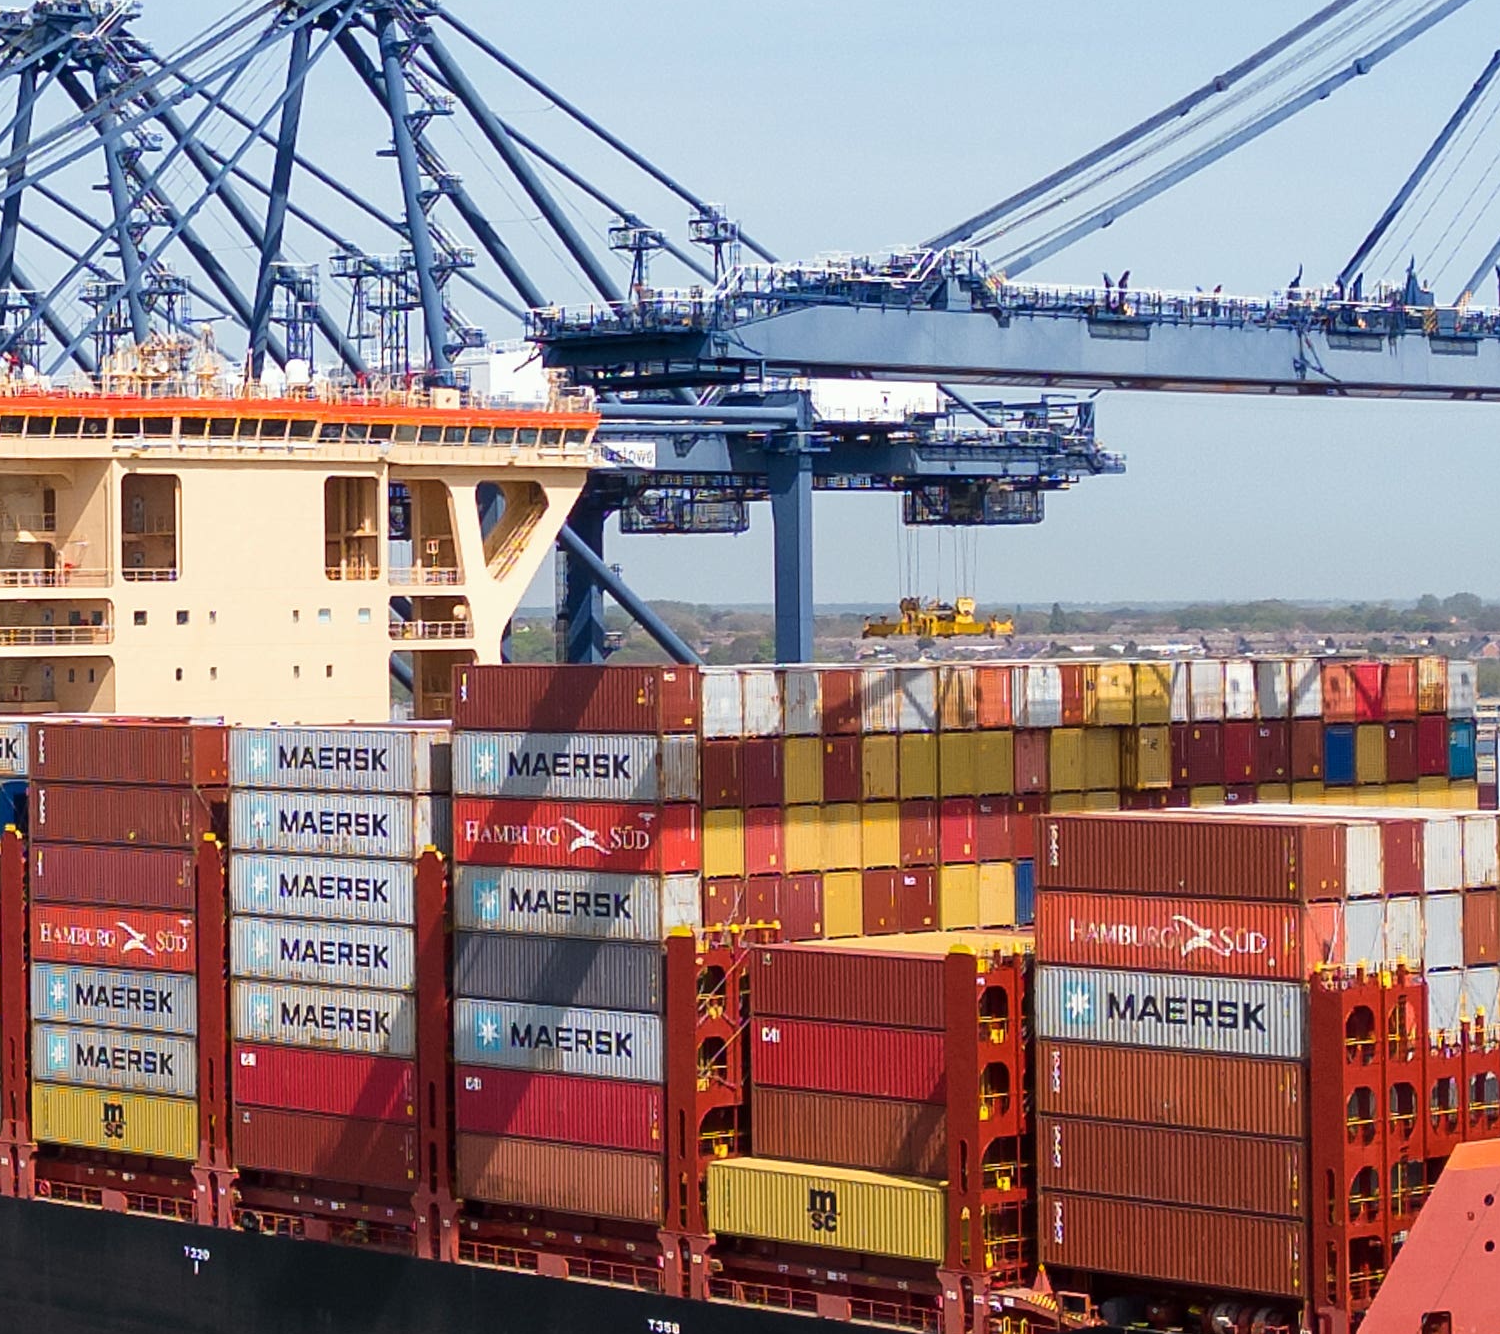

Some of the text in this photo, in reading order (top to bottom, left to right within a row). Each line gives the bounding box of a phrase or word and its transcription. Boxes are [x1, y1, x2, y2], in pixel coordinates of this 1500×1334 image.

[278, 745, 387, 772] MAERSK
[508, 751, 631, 780] MAERSK
[279, 811, 388, 838] MAERSK
[465, 819, 650, 851] HAMBURG SÜD
[279, 874, 388, 903] MAERSK
[509, 886, 631, 920] MAERSK
[40, 922, 117, 948] HAMBURG
[1069, 917, 1180, 949] HAMBURG
[280, 938, 388, 969] MAERSK
[75, 983, 173, 1014] MAERSK
[1107, 992, 1268, 1033] MAERSK
[281, 1001, 390, 1035] MAERSK
[510, 1021, 633, 1059] MAERSK
[76, 1043, 174, 1076] MAERSK
